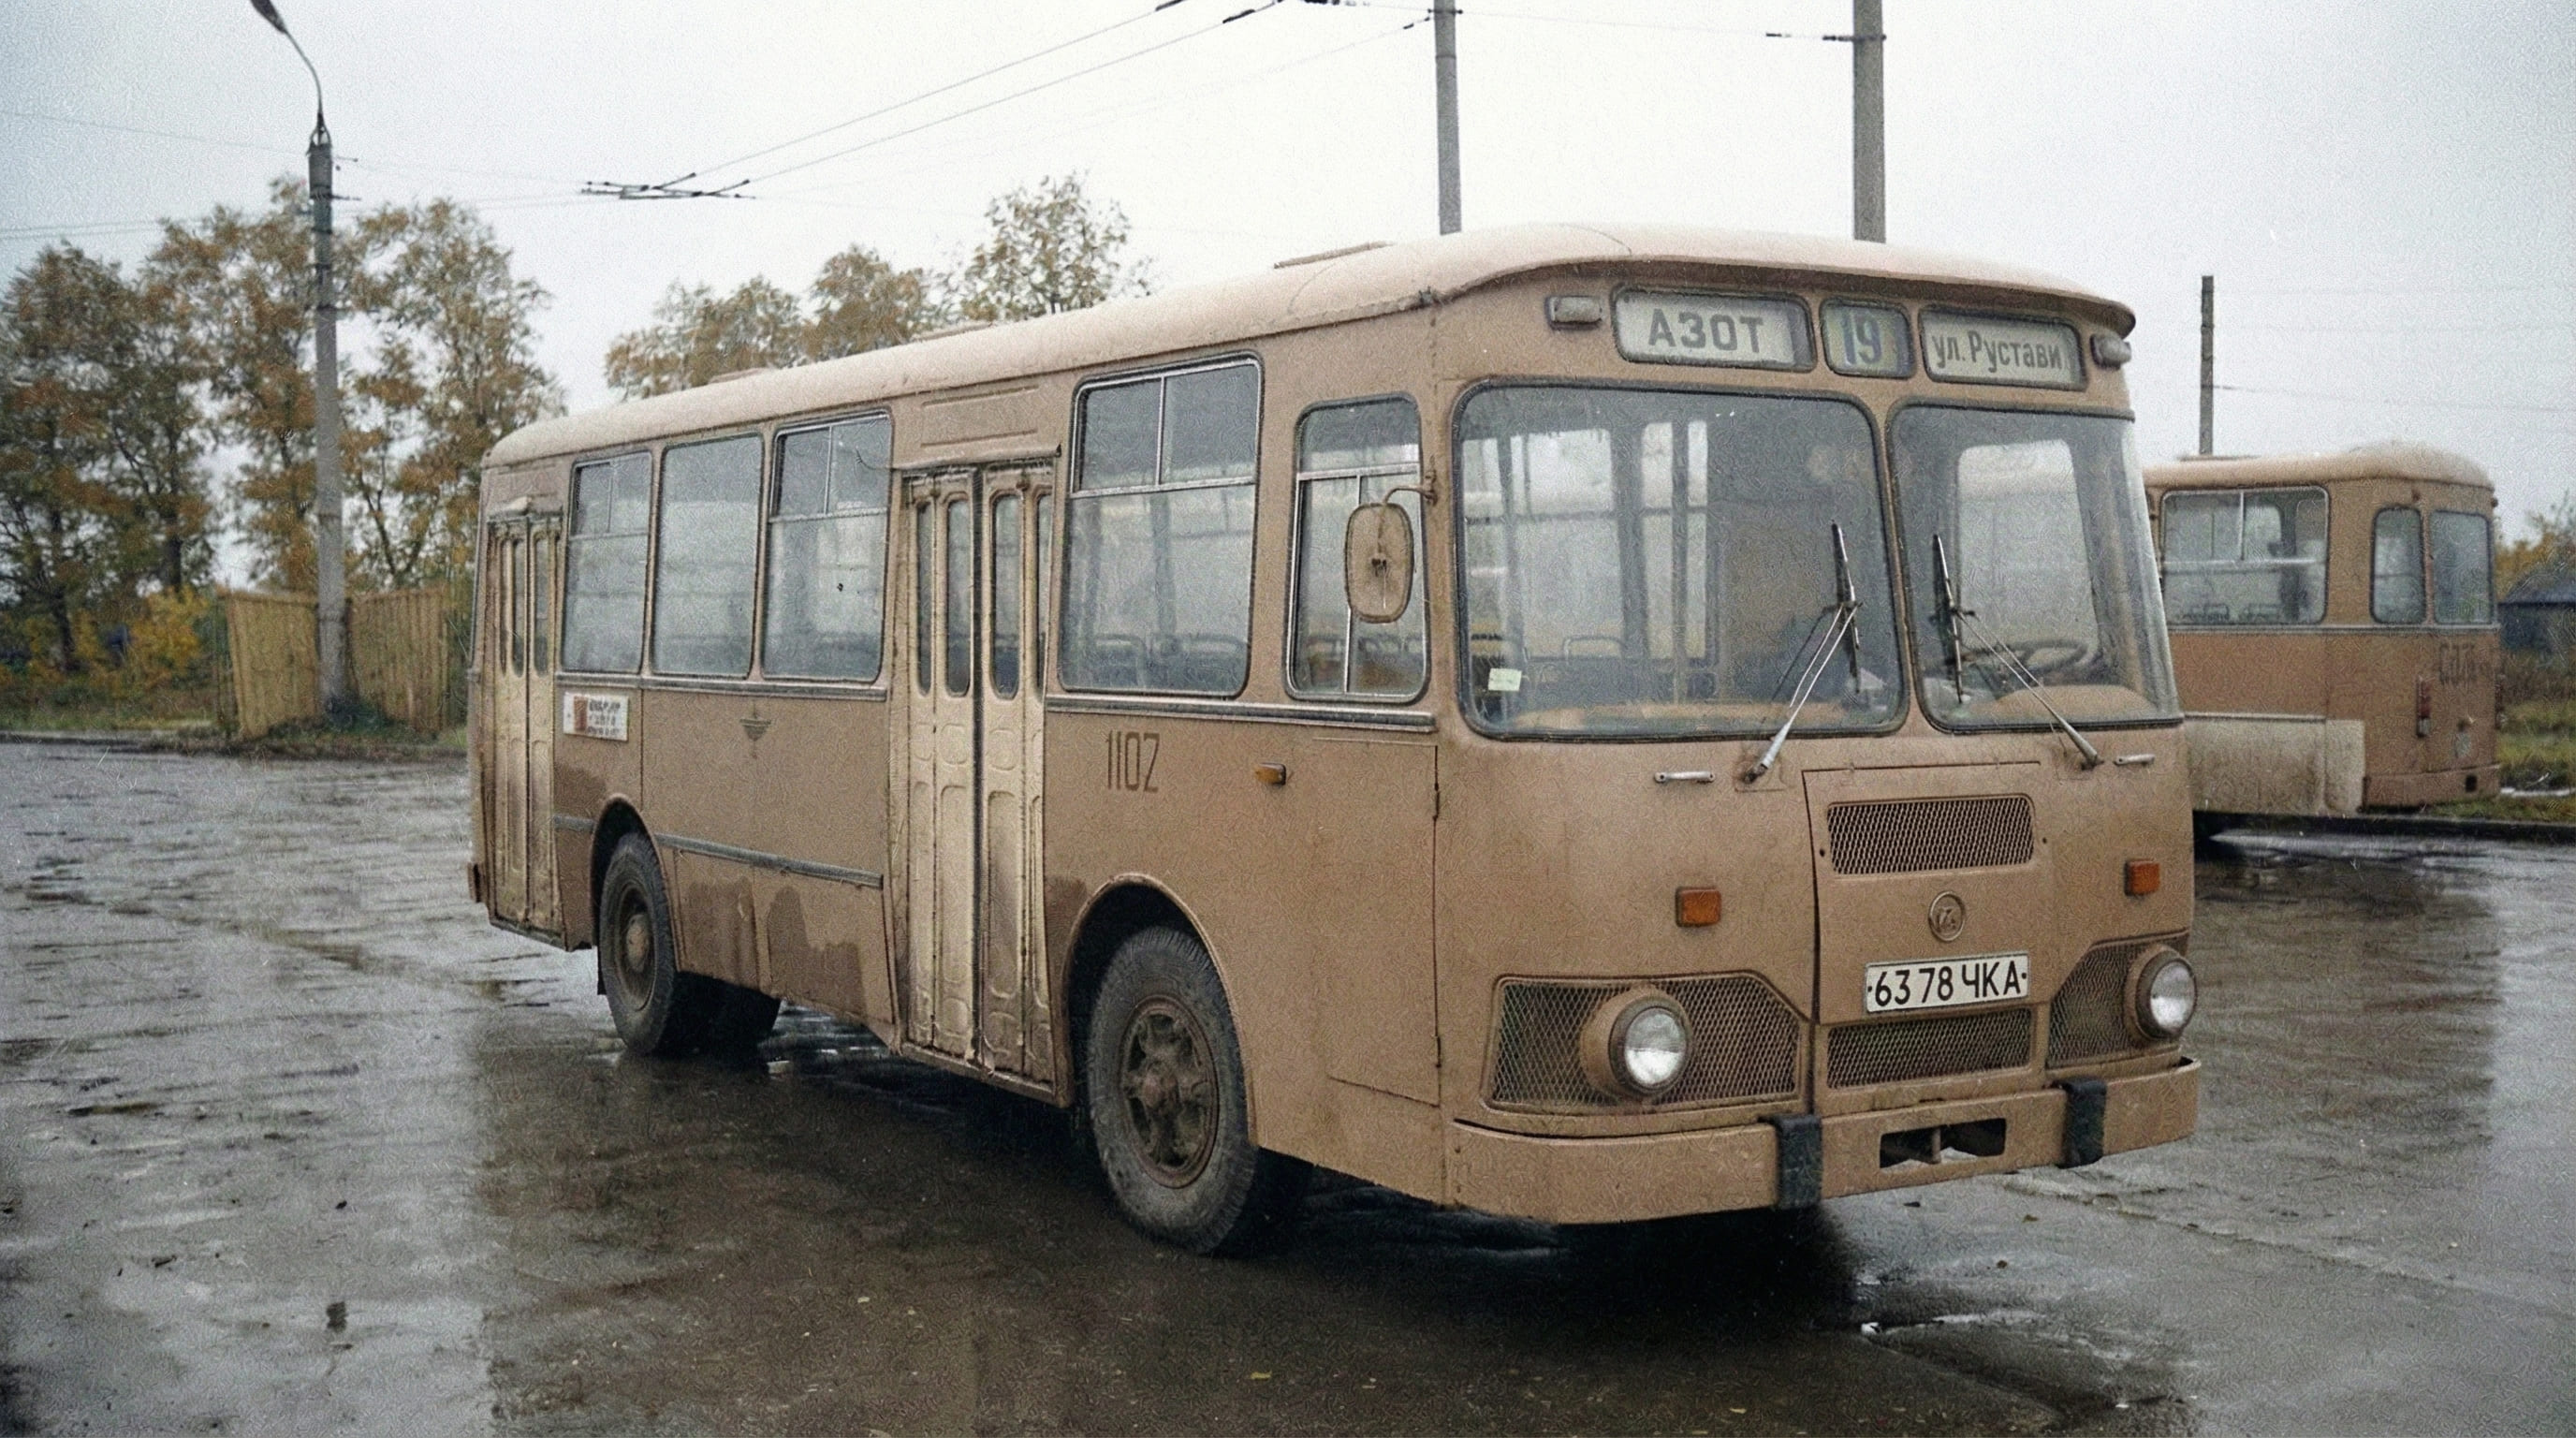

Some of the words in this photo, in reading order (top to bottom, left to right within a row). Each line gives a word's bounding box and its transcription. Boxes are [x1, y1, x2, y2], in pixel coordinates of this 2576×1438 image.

[1648, 308, 1764, 353] АЗОТ
[1839, 312, 1882, 366] 19
[1106, 731, 1160, 792] 1102
[1962, 961, 2021, 998] ЧКА
